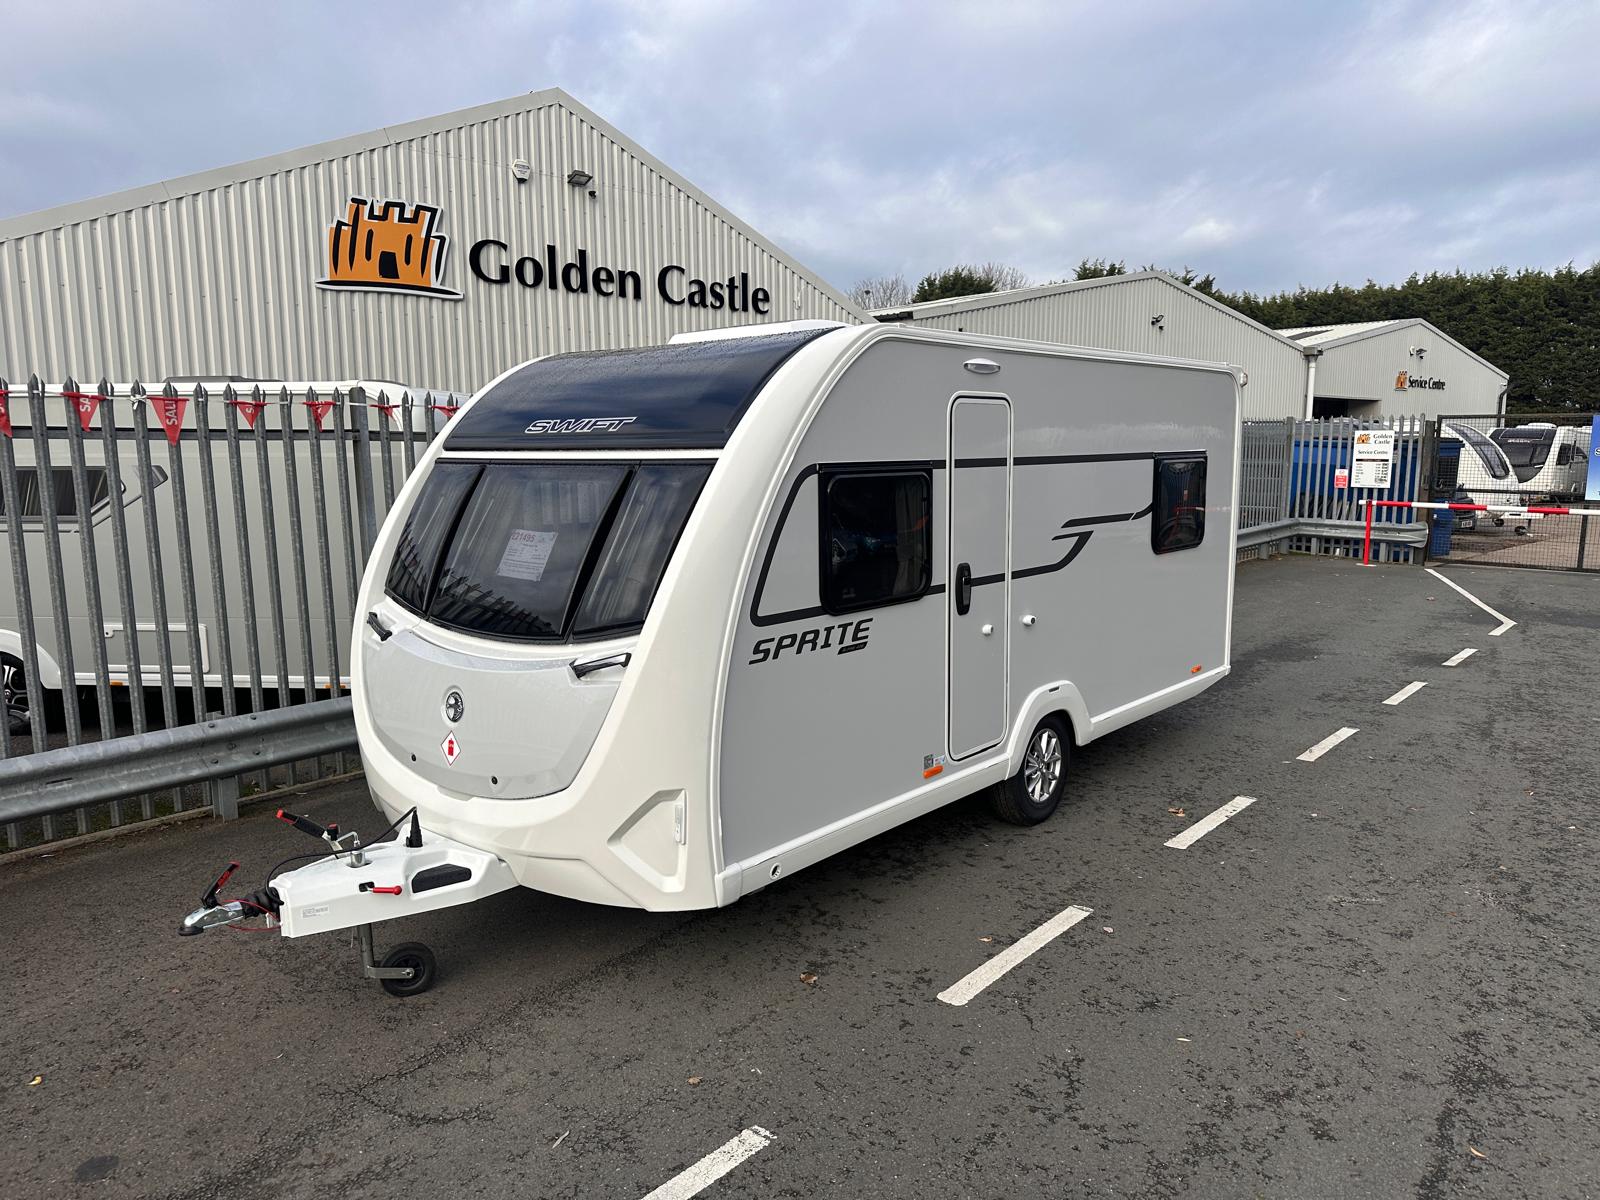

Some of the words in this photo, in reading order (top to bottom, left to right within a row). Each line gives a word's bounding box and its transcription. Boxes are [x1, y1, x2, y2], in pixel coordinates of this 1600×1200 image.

[469, 239, 642, 300] Golden
[657, 264, 771, 315] Castle
[1408, 375, 1428, 389] Service
[1428, 377, 1446, 391] Centre
[524, 416, 638, 434] SWIFT
[748, 617, 874, 665] SPRITE
